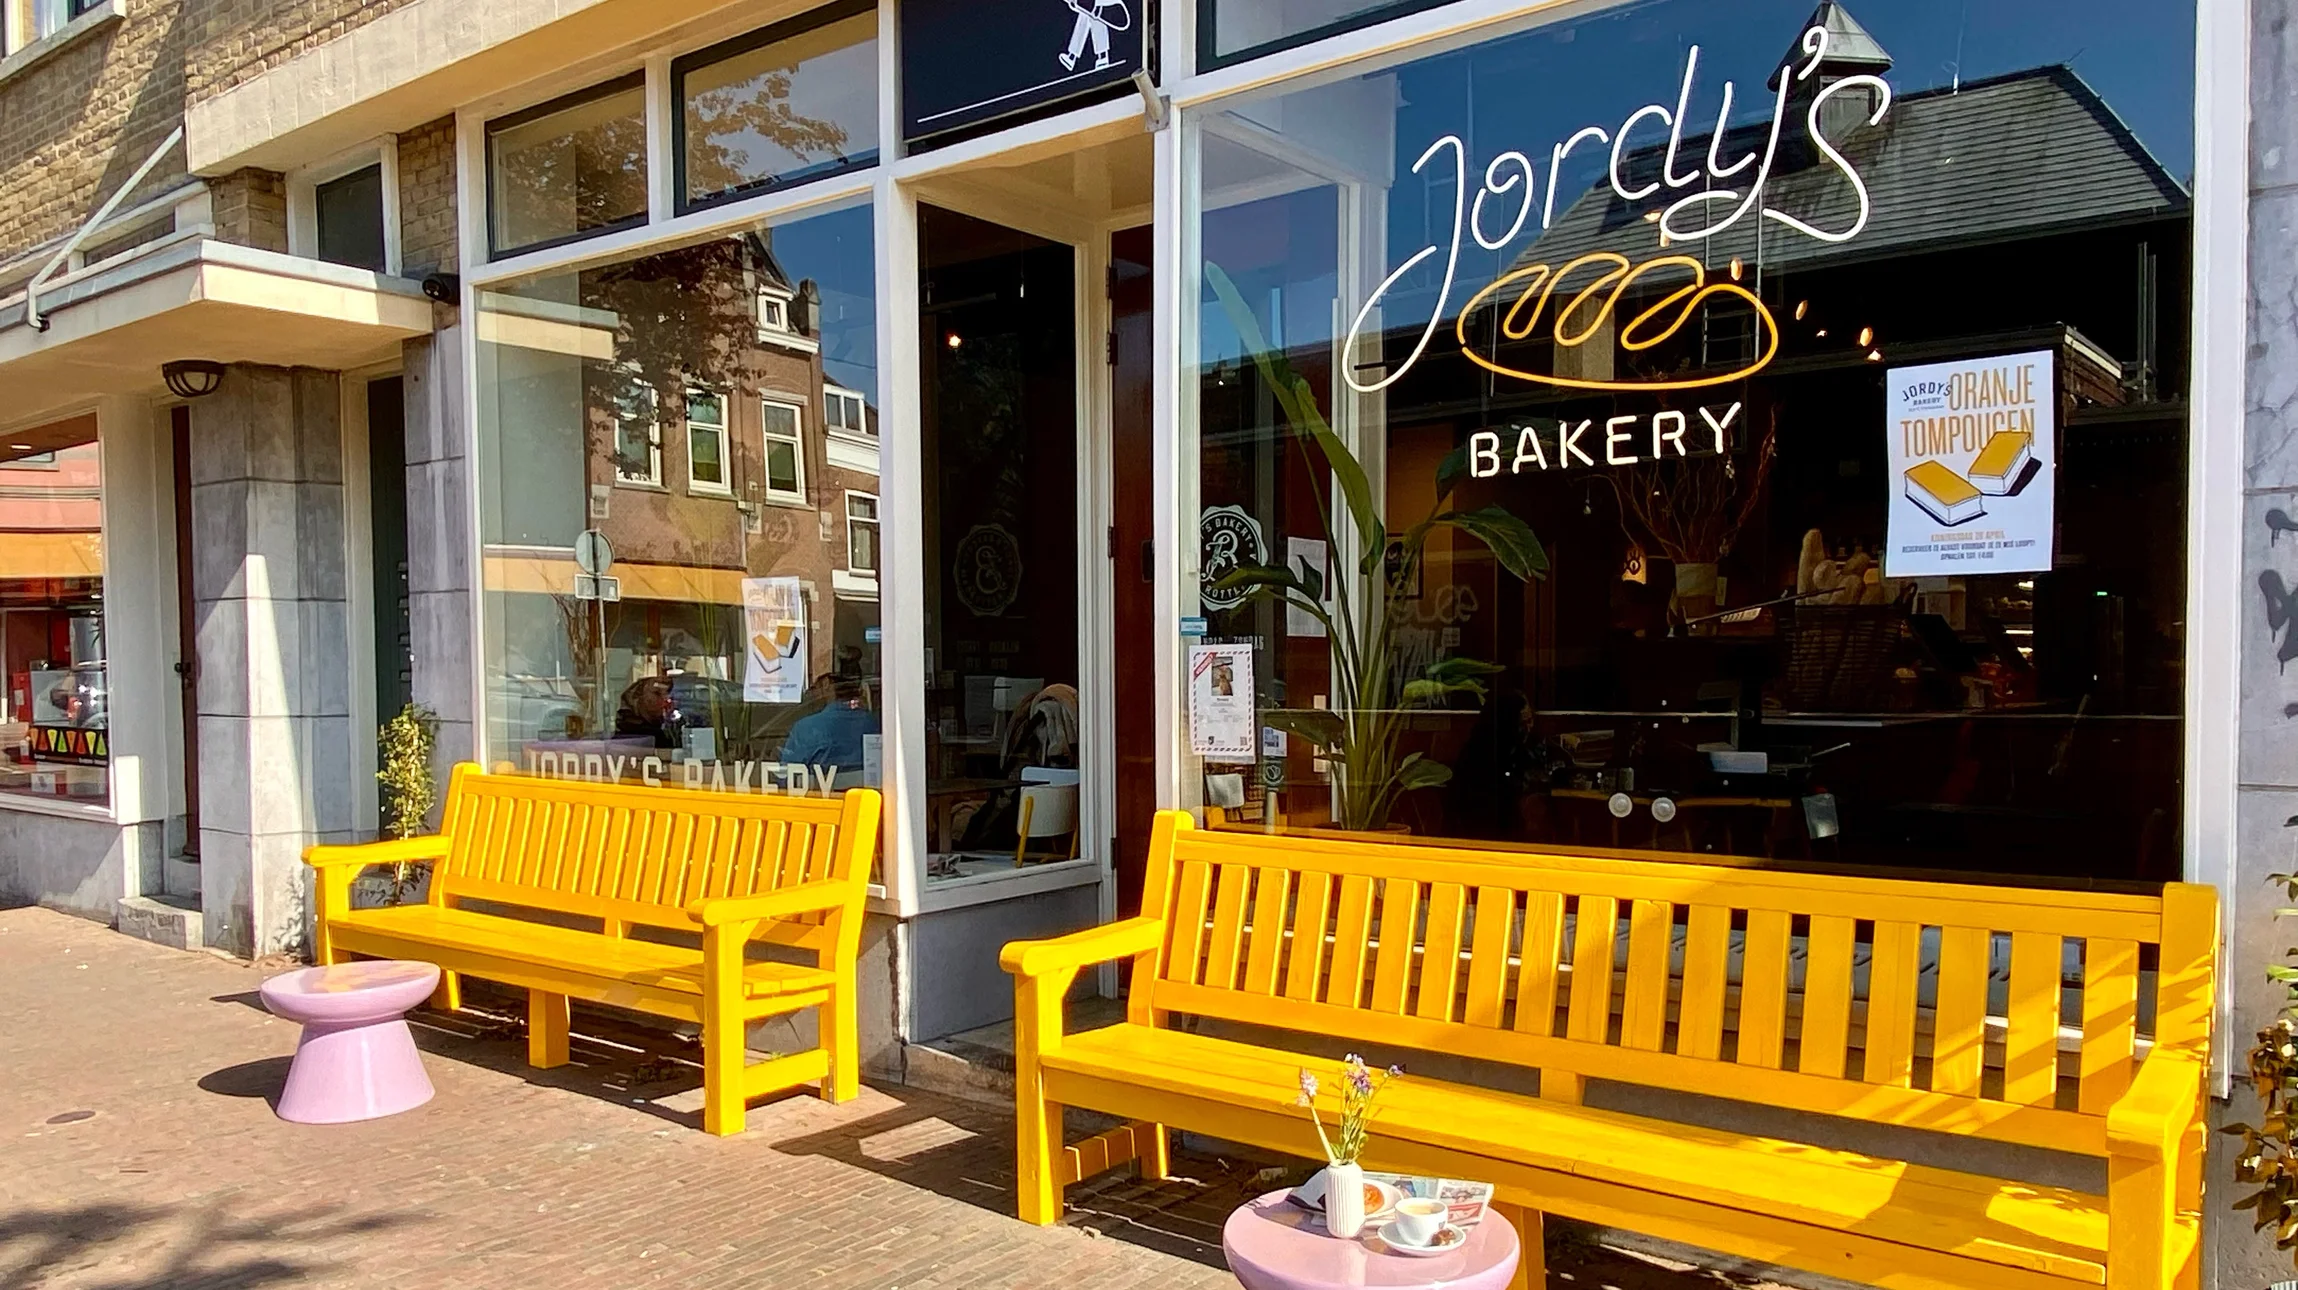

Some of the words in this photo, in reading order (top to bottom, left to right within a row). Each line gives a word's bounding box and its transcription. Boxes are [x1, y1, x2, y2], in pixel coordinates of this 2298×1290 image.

[1341, 25, 1893, 394] Jordy's
[1902, 381, 1952, 402] JORDY'S
[1949, 364, 2035, 412] ORANJE
[1470, 402, 1742, 479] BAKERY
[529, 751, 664, 788] JORDY'S
[684, 758, 838, 799] BAKERY
